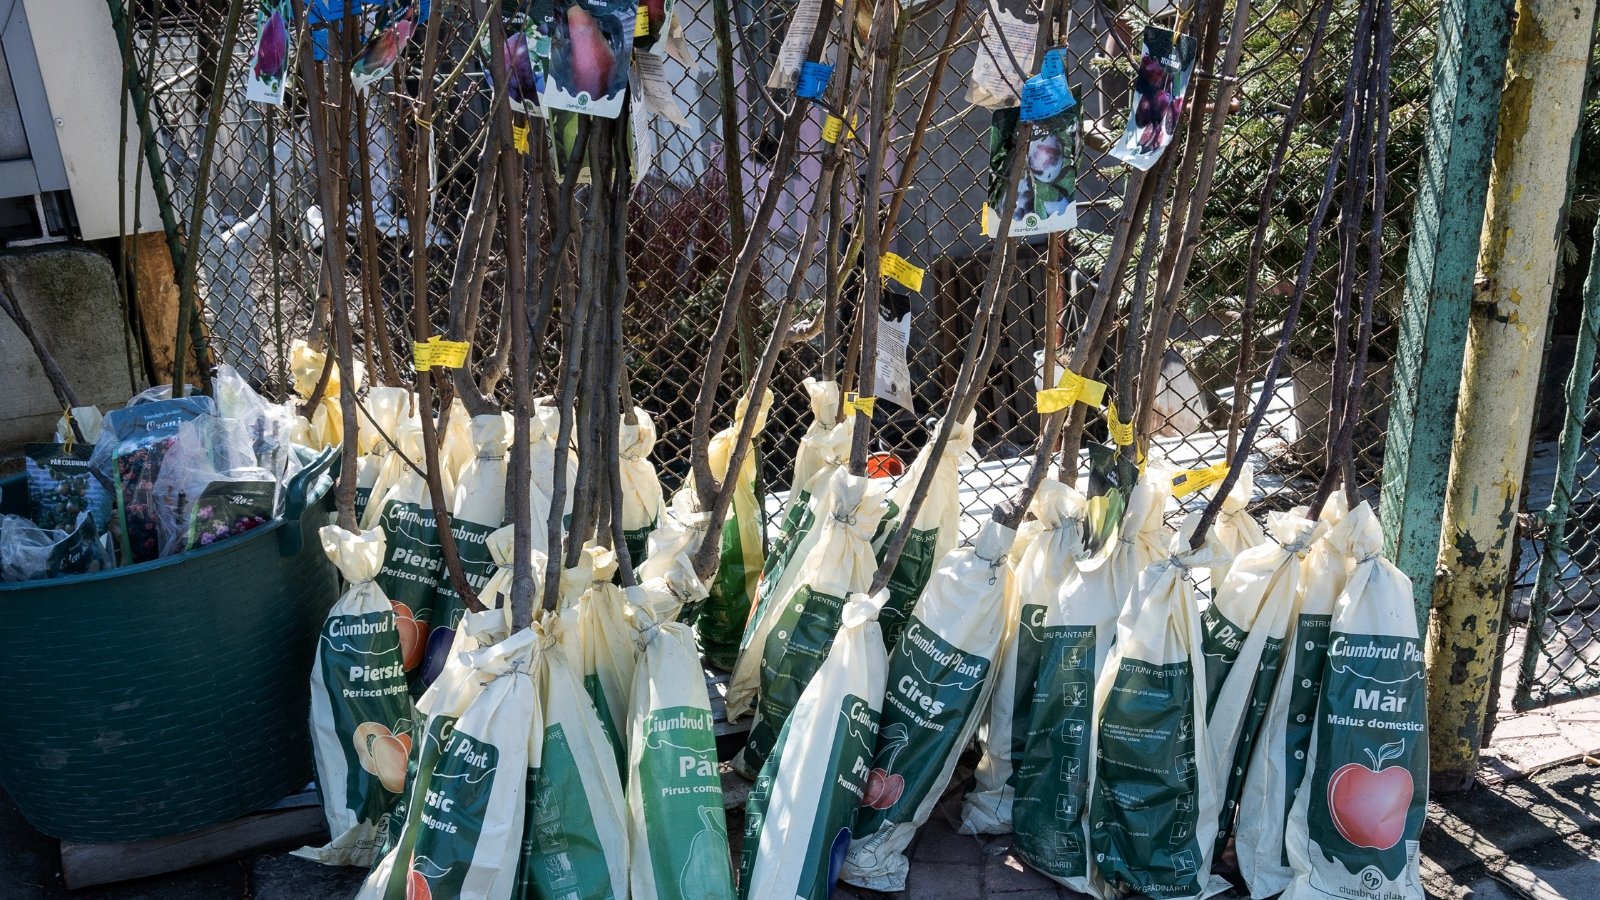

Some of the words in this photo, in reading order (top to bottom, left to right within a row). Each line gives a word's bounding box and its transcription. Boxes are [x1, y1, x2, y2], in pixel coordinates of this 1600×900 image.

[381, 566, 417, 581] Perisca
[329, 616, 388, 637] Ciumbrud
[1055, 631, 1093, 639] PLANTARE
[907, 623, 955, 667] Ciumbrud
[949, 652, 982, 679] Plant
[1332, 636, 1401, 660] Ciumbrud
[342, 688, 382, 698] Perisca
[897, 675, 945, 719] Cireș
[1353, 689, 1406, 713] Măr
[885, 691, 916, 719] Cerasus
[915, 716, 945, 732] avium
[1327, 714, 1365, 727] Malus
[1367, 718, 1424, 732] domestica
[454, 738, 489, 769] Plant
[680, 754, 719, 778] Păr
[661, 786, 691, 797] Pirus
[1340, 885, 1380, 900] ciumbrud
